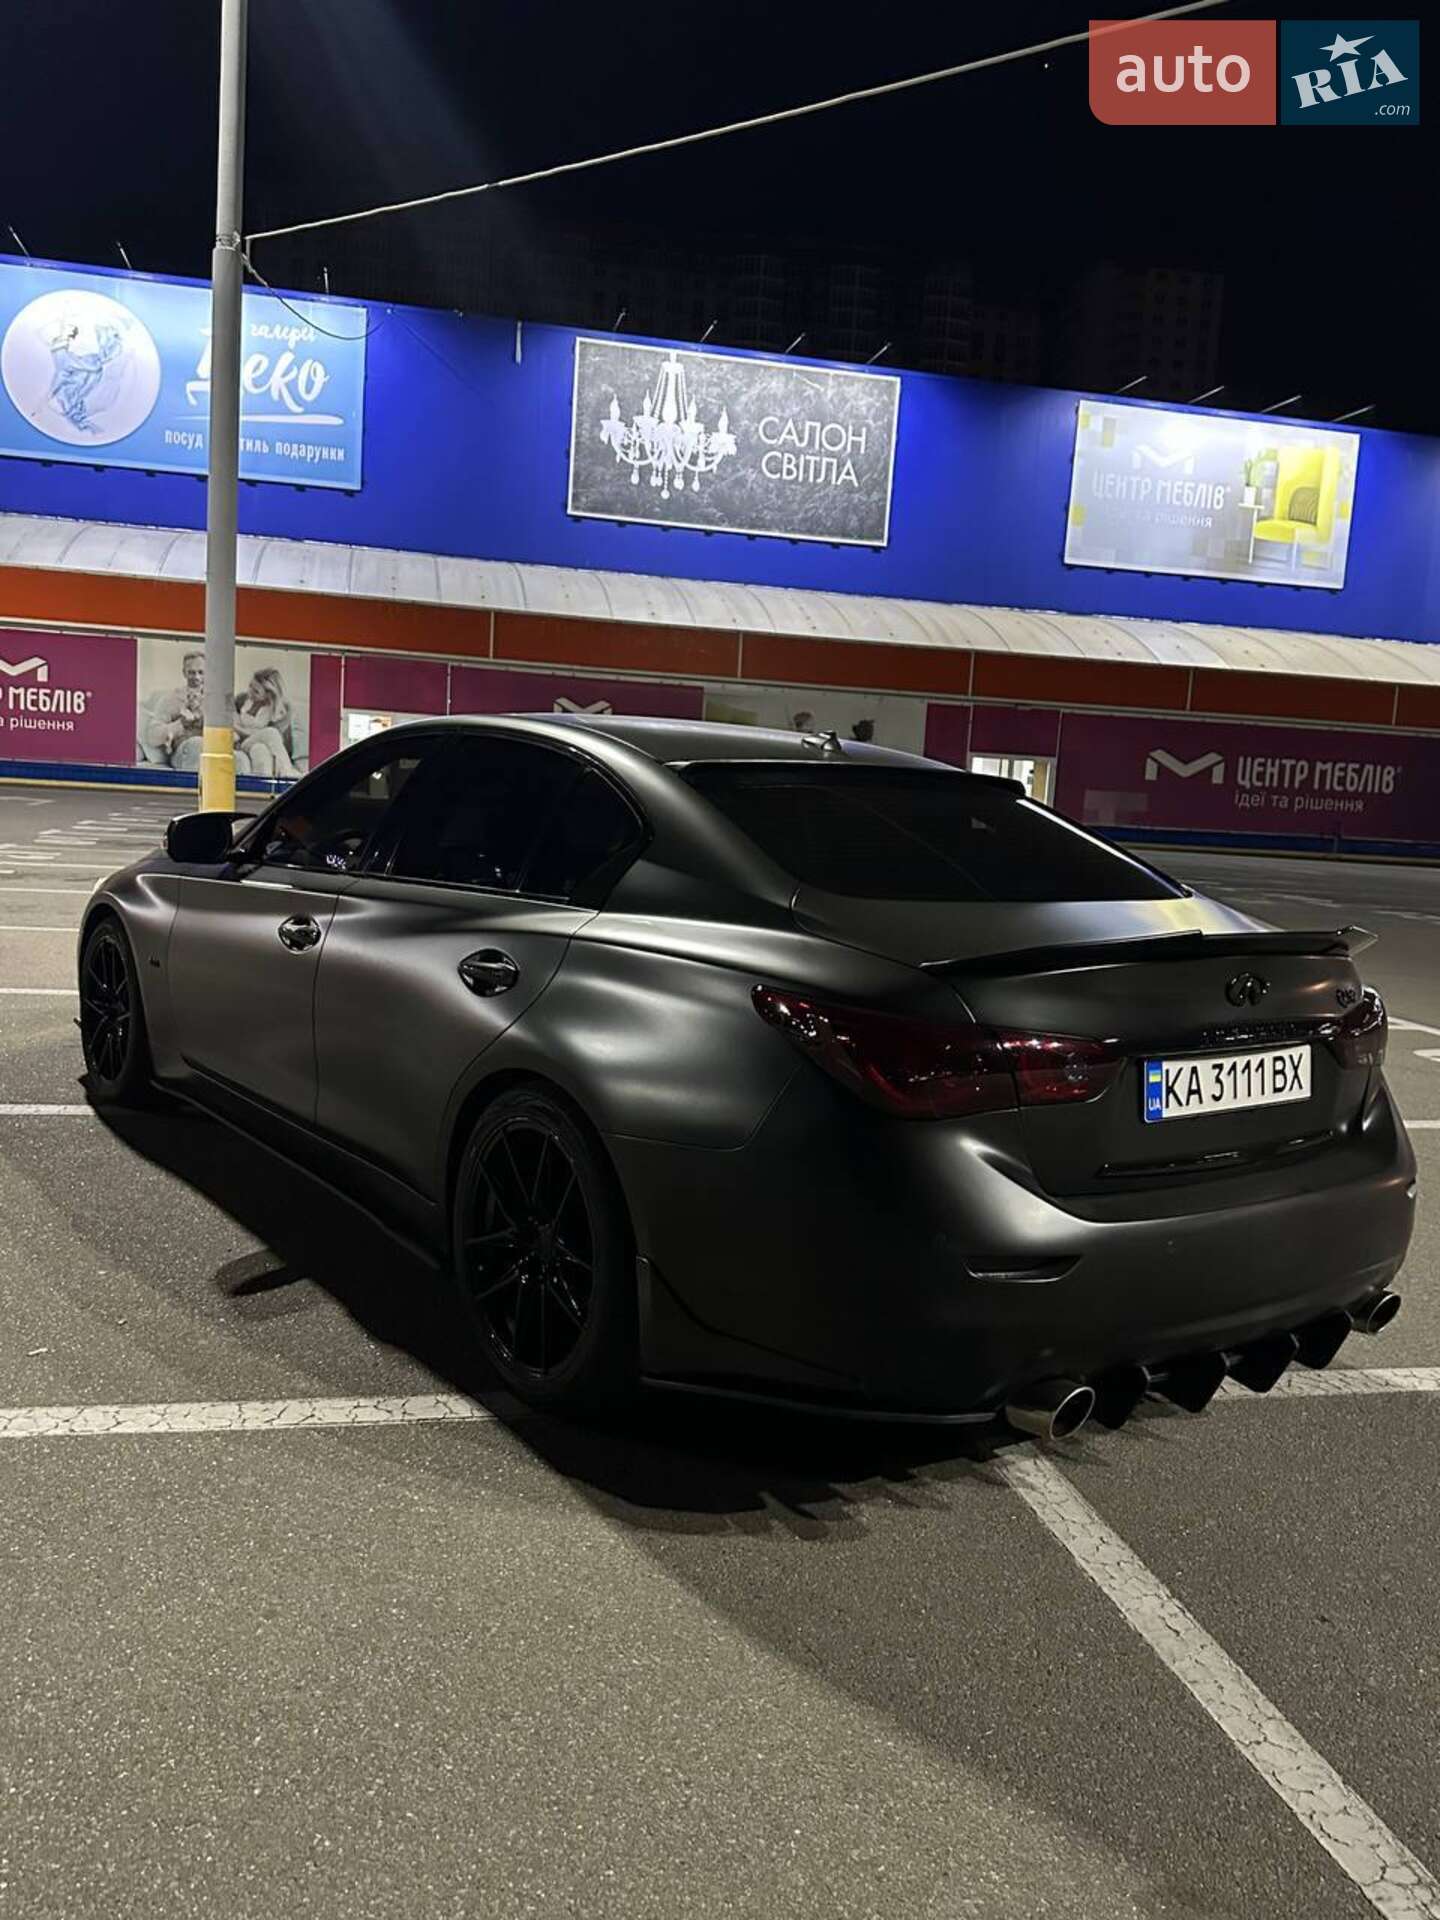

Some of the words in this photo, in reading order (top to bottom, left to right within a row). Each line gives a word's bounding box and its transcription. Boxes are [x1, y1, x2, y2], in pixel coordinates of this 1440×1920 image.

[758, 415, 867, 454] САЛОН
[275, 440, 345, 463] подарунки
[761, 450, 859, 487] СВІТЛА
[1092, 469, 1152, 502] ЦЕНТР
[10, 714, 75, 732] рішення
[1236, 756, 1309, 790] ЦЕНТР
[1234, 790, 1266, 809] ідеї
[1271, 795, 1289, 808] та
[1293, 794, 1364, 813] рішення
[1165, 1065, 1203, 1109] KA
[1211, 1057, 1265, 1102] 3111
[1272, 1053, 1304, 1094] BX
[1149, 1097, 1162, 1111] UA
